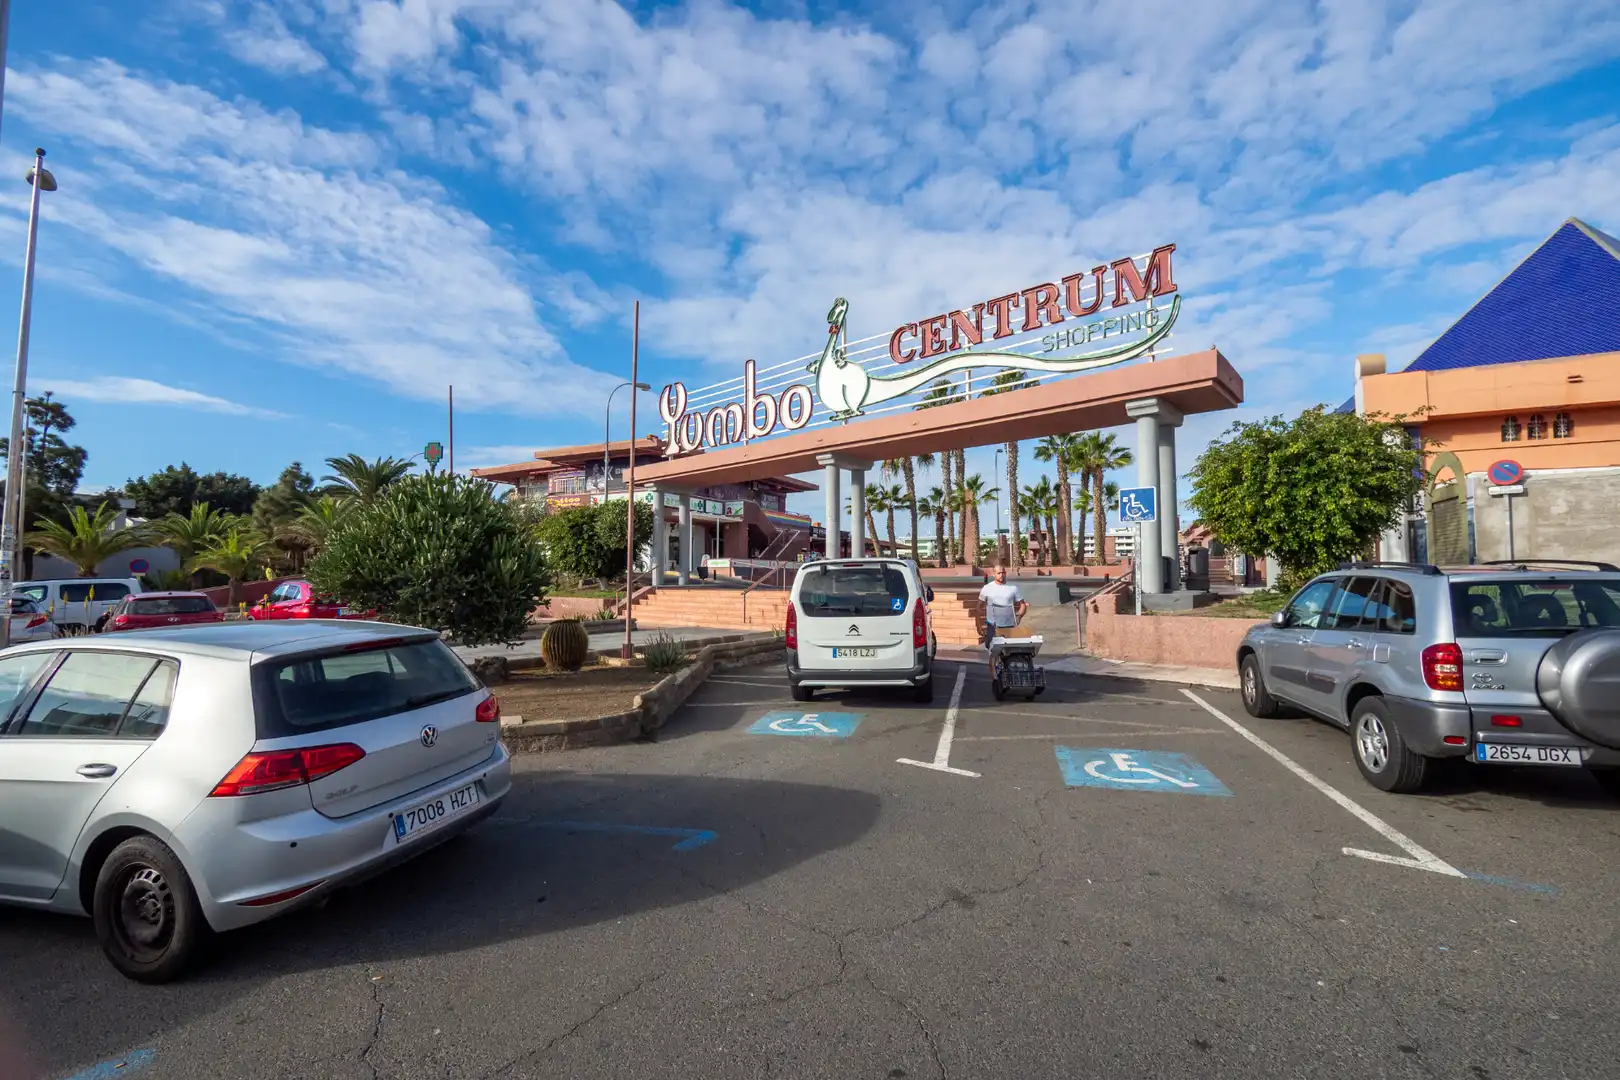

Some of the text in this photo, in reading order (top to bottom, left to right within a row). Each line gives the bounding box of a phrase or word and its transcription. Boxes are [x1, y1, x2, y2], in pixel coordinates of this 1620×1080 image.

[889, 243, 1178, 364] CENTRUM
[1041, 306, 1161, 353] SHOPPING
[659, 359, 813, 456] Yumbo
[837, 648, 876, 657] 5418 LZJ
[1489, 746, 1571, 762] 2654 DGX
[406, 786, 475, 831] 7008 HZT
